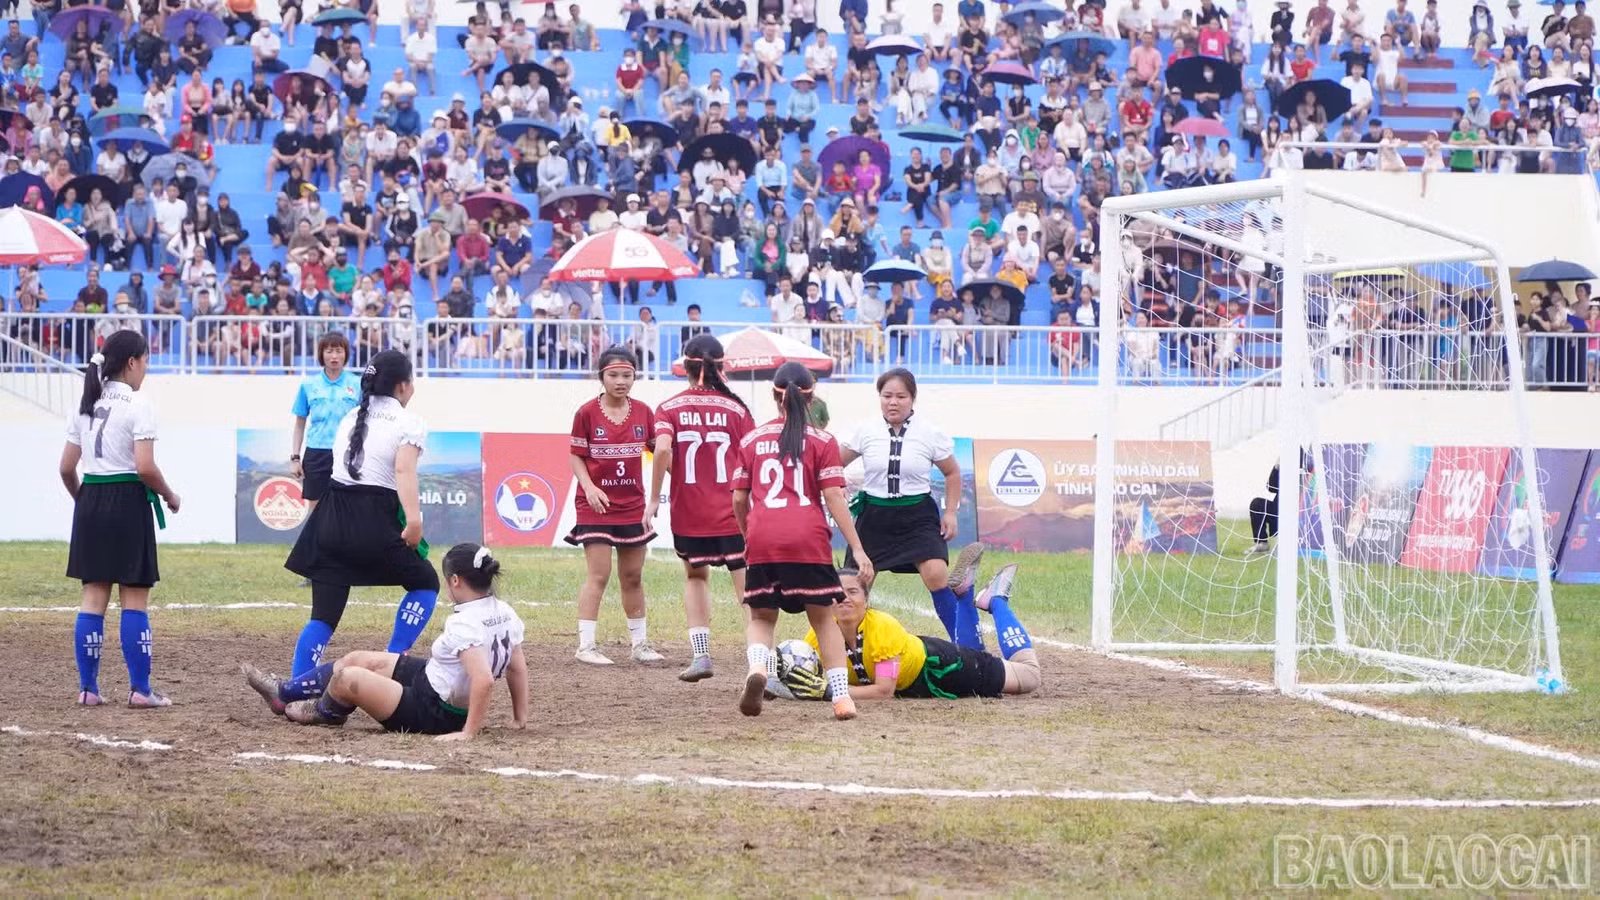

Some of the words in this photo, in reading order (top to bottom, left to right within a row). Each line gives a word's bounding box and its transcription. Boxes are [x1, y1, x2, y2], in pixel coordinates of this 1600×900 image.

[729, 357, 775, 368] viettel
[679, 412, 702, 426] GIA
[705, 413, 727, 427] LAI
[90, 406, 112, 458] 7
[756, 440, 780, 455] GIA
[677, 430, 731, 484] 77
[616, 461, 626, 477] 3
[760, 457, 811, 509] 21
[1130, 483, 1157, 495] CAI
[447, 489, 467, 506] LỘ
[517, 516, 535, 524] VFF
